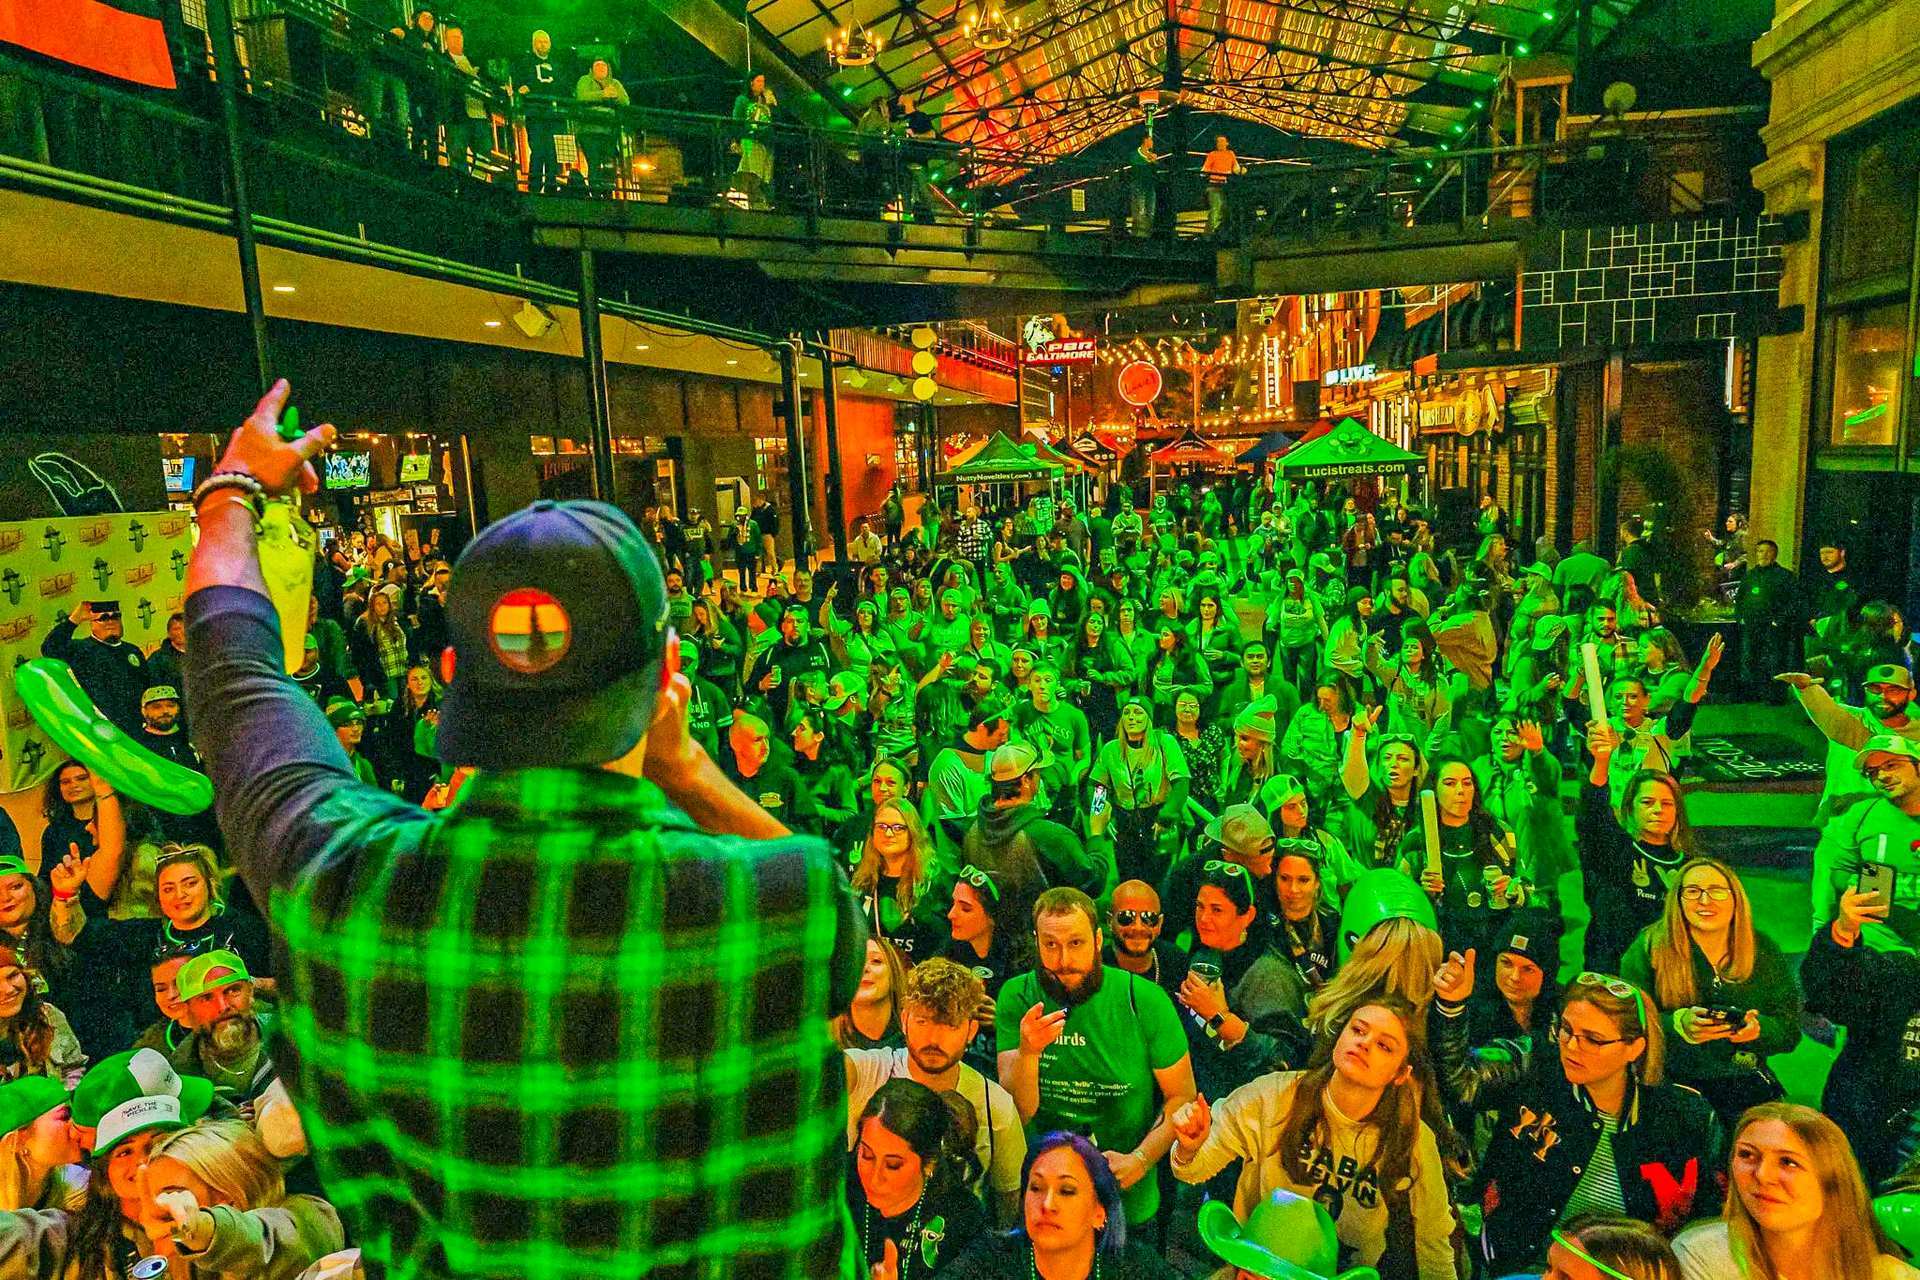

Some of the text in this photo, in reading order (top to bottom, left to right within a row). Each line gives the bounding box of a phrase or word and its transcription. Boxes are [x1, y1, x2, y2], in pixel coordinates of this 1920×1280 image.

[536, 63, 554, 83] C
[1048, 341, 1093, 352] PBR
[1027, 350, 1094, 362] BALTIMORE
[1304, 464, 1405, 477] Lucistreats.com
[1636, 888, 1656, 899] Peace
